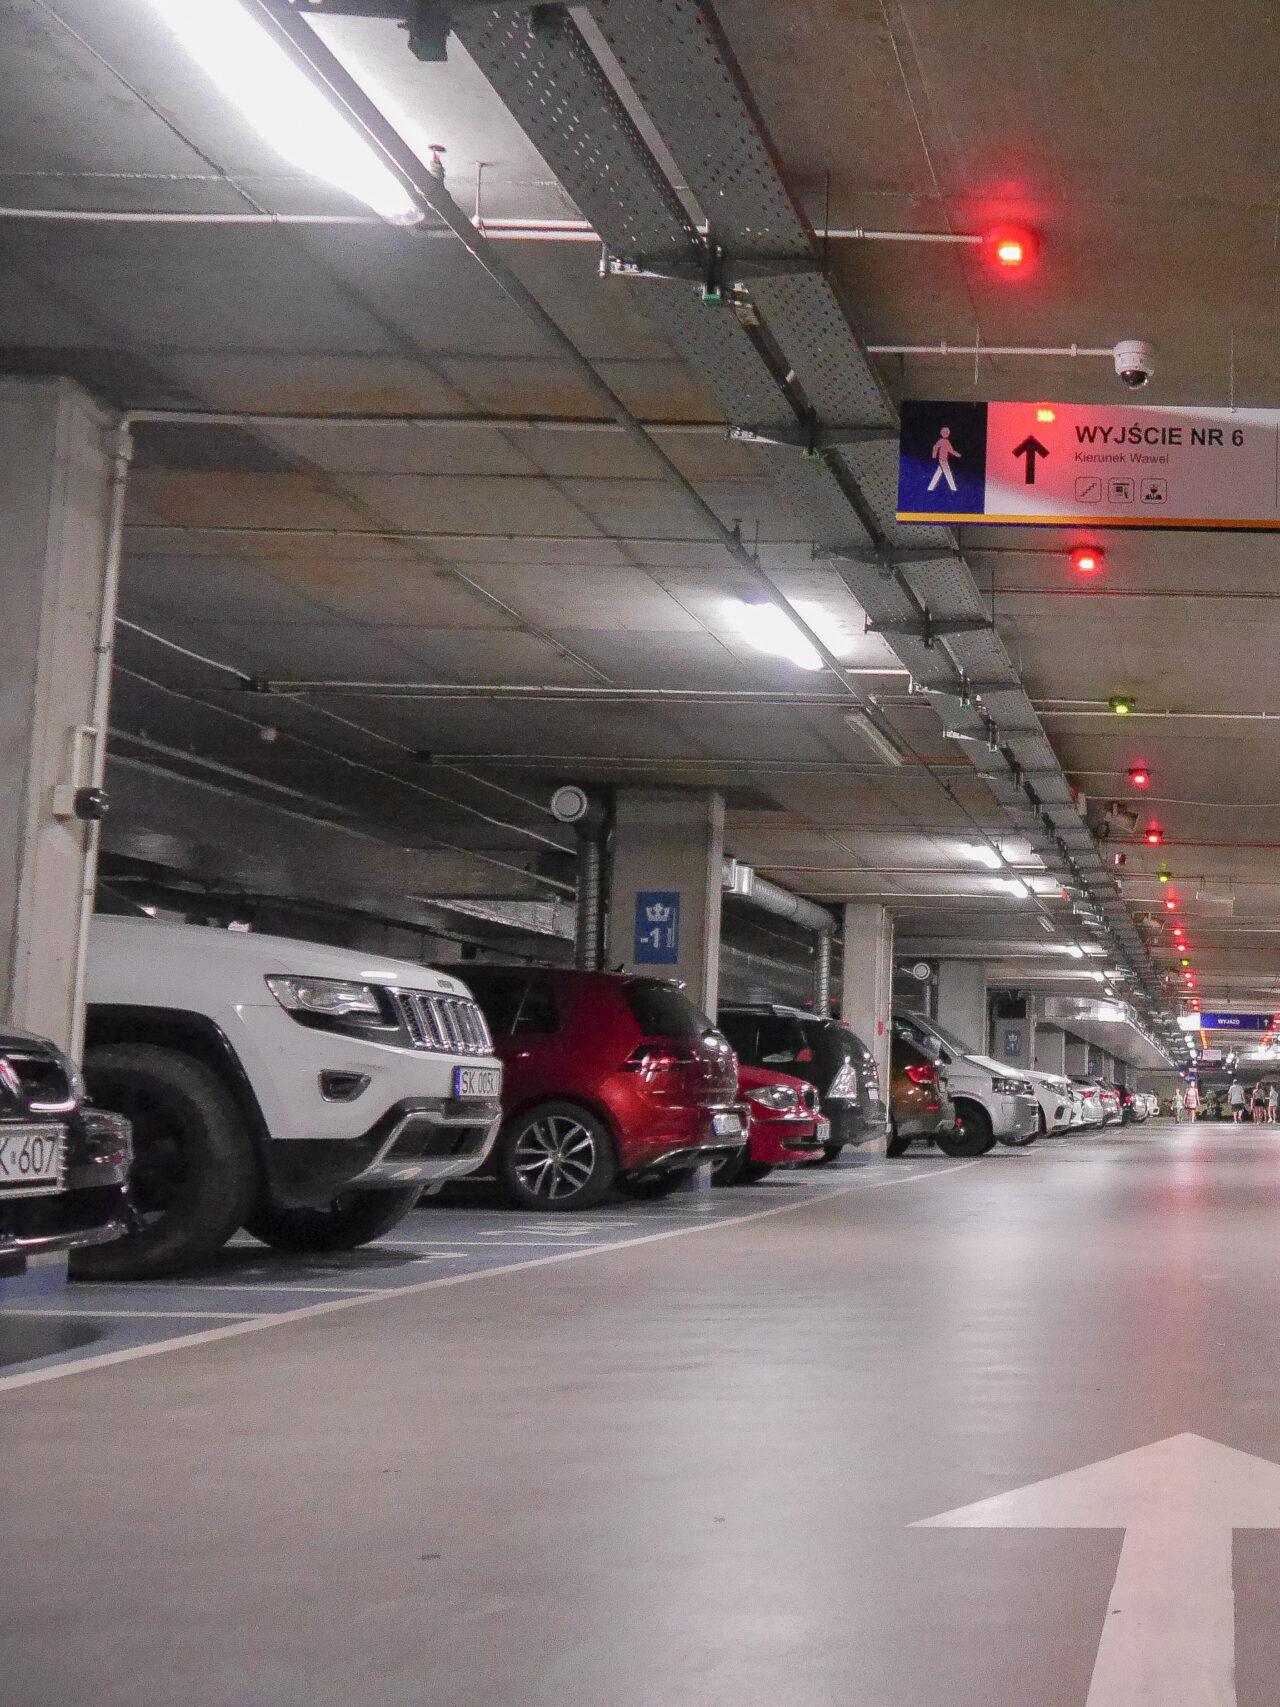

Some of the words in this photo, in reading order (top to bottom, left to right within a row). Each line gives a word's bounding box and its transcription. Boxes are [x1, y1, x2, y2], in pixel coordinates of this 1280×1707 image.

[1074, 422, 1182, 446] WYJŚCIE
[1190, 427, 1224, 446] NR
[1231, 429, 1244, 447] 6
[1074, 451, 1126, 464] Kierunek
[1129, 452, 1169, 464] Wawel
[640, 927, 660, 949] -1
[18, 1135, 57, 1175] 607
